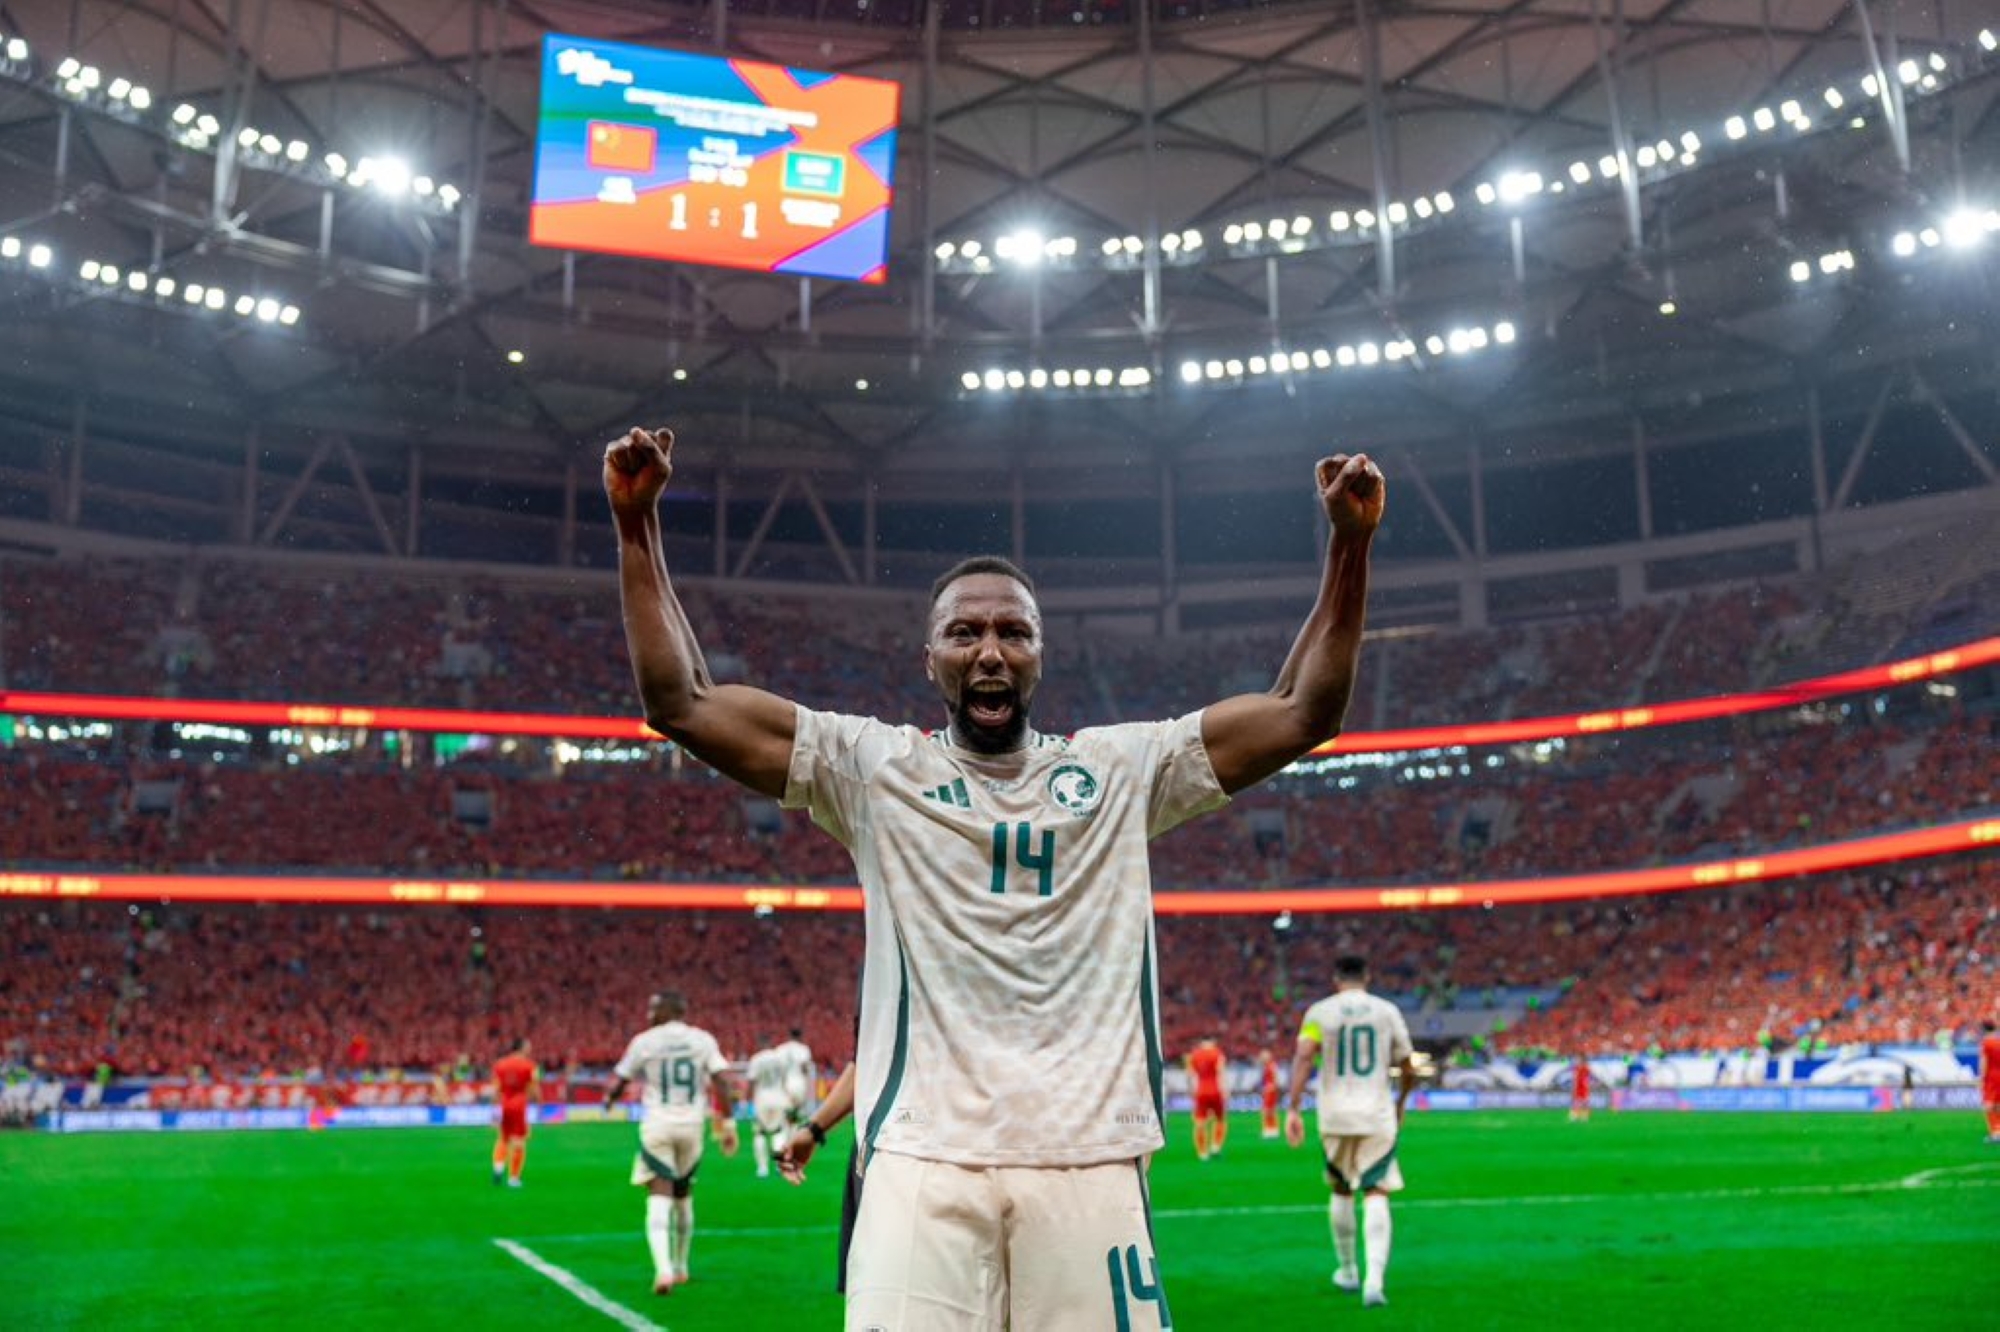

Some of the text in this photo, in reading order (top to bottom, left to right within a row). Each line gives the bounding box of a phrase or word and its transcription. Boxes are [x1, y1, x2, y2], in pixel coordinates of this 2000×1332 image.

[669, 192, 687, 231] 1
[709, 207, 721, 229] :
[741, 201, 759, 239] 1
[991, 821, 1055, 896] 14
[1337, 1024, 1375, 1076] 10
[661, 1058, 695, 1104] 19
[1107, 1244, 1171, 1332] 14
